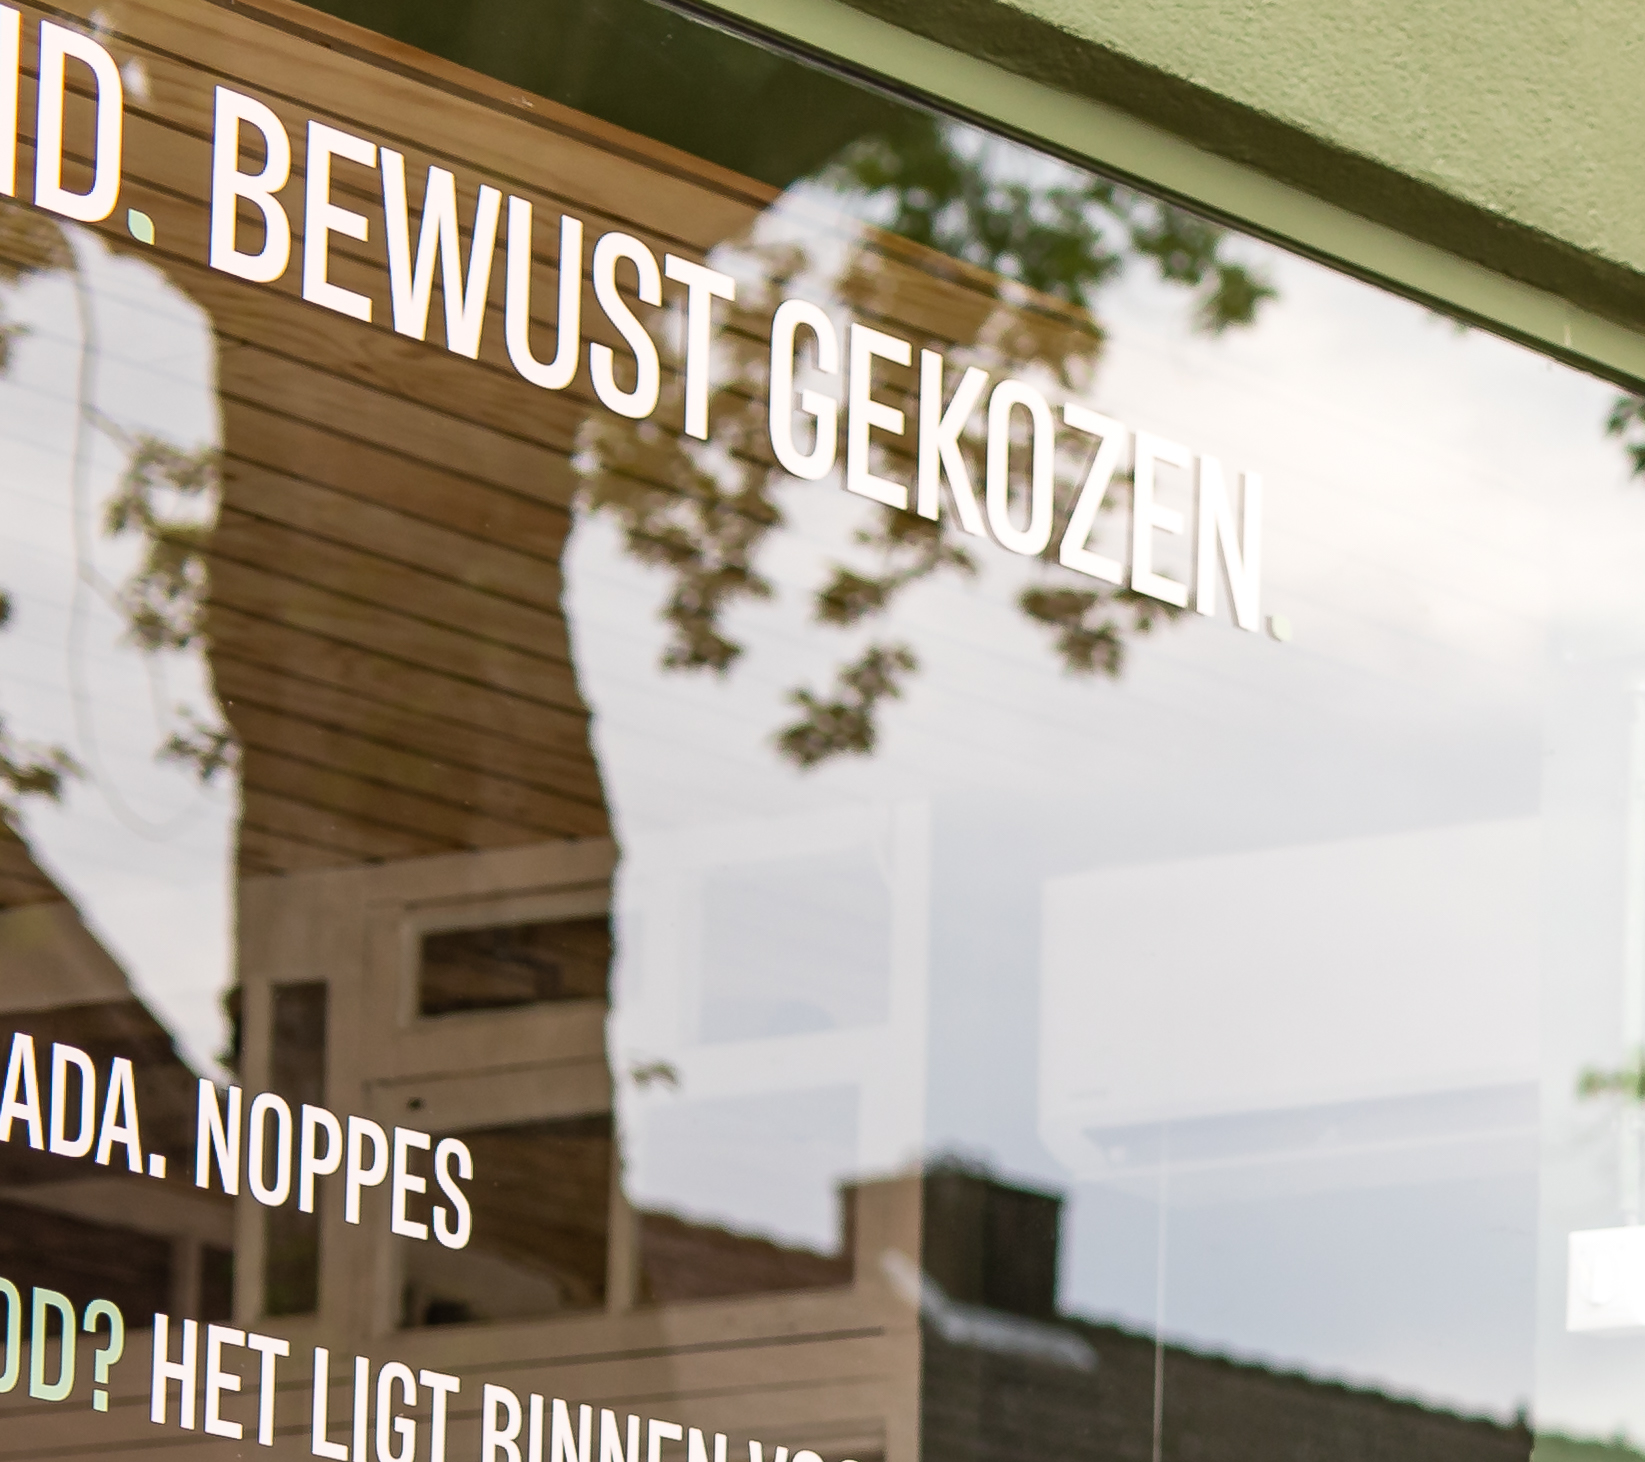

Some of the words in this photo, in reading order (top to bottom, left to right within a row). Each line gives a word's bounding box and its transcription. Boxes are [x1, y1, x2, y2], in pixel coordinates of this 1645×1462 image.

[208, 85, 735, 442] BEWUST
[195, 1078, 473, 1250] NOPPES
[150, 1313, 290, 1447] HET
